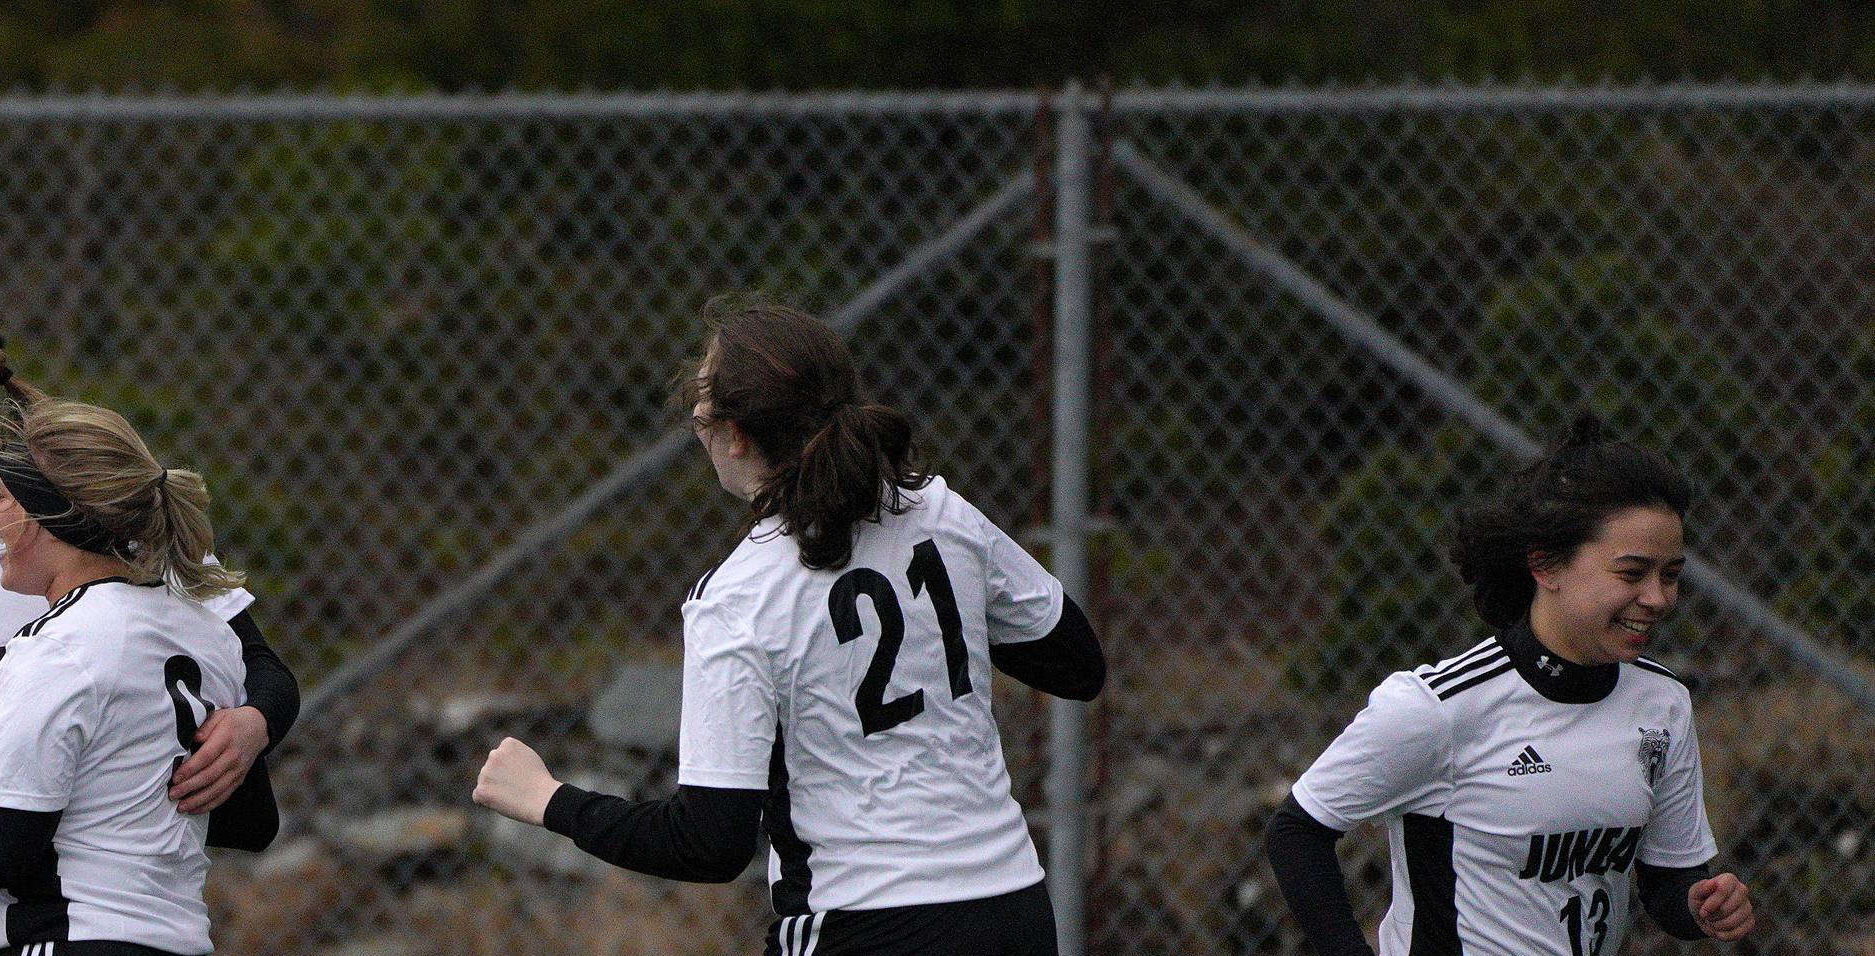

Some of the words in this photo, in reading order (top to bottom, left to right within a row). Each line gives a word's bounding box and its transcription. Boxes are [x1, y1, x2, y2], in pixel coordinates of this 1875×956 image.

[828, 538, 974, 738] 21
[1507, 761, 1552, 776] adidas
[1519, 825, 1644, 884] JUNEA
